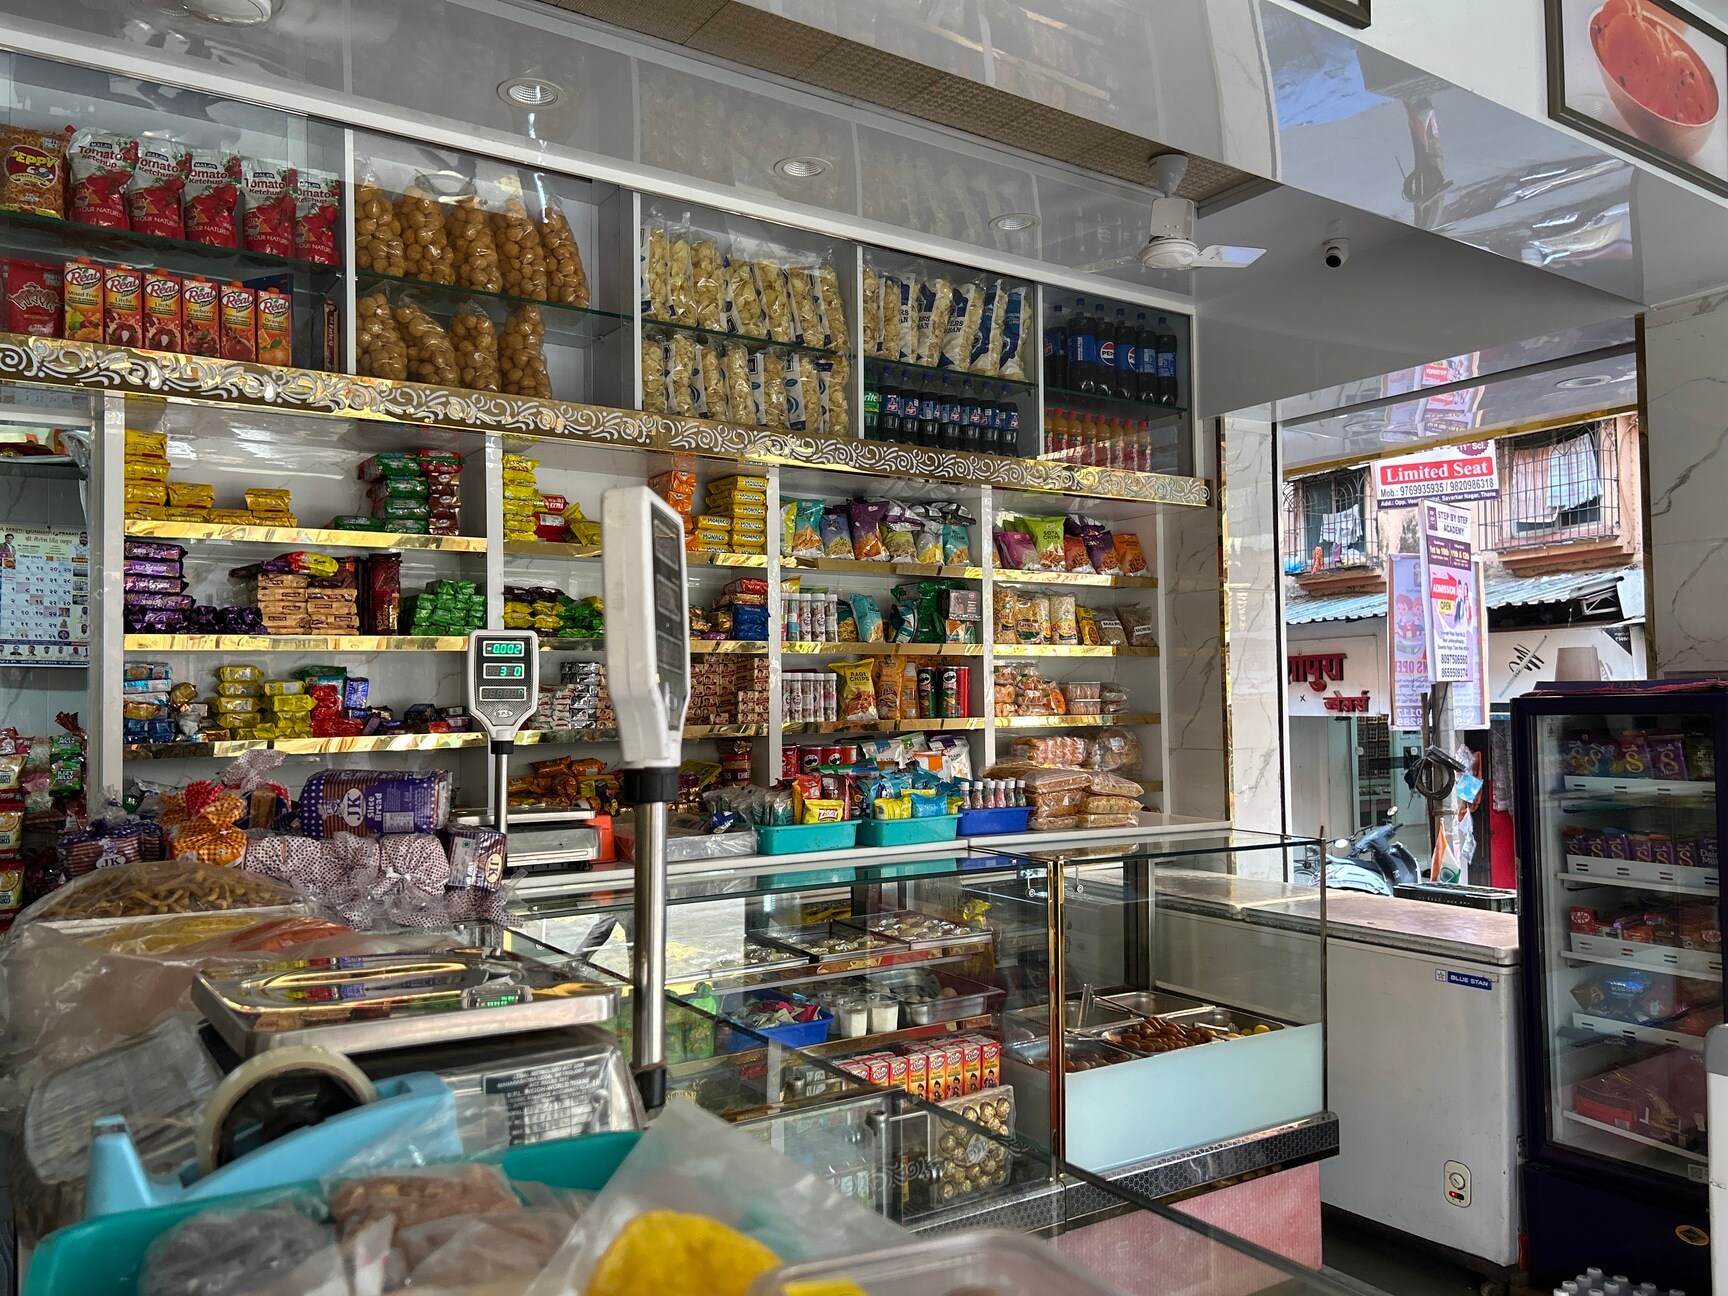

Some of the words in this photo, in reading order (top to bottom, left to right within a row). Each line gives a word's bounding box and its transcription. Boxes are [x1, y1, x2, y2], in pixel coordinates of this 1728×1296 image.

[9, 150, 58, 168] PEPPY
[78, 145, 123, 161] Tomato
[81, 154, 117, 169] Ketchup
[139, 157, 179, 173] omato
[138, 166, 174, 178] Ketchup
[190, 169, 228, 179] omato
[244, 178, 286, 189] Tomato
[298, 189, 332, 199] omato
[71, 271, 98, 284] Real
[110, 278, 138, 292] Real
[150, 283, 178, 297] Real
[188, 289, 215, 301] Real
[225, 295, 252, 307] Real
[186, 307, 215, 316] Cranberry
[263, 300, 288, 312] Real
[1386, 464, 1449, 482] Limited
[1453, 461, 1488, 476] Seat
[1380, 489, 1399, 498] Mob.:
[1400, 483, 1444, 496] 9769935935
[1450, 478, 1494, 491] 9820986318
[1438, 511, 1449, 520] STEP
[1450, 513, 1456, 522] BY
[1457, 515, 1468, 524] STEP
[1444, 524, 1465, 536] ACADEMY
[702, 533, 726, 541] MONACO
[1440, 601, 1452, 611] OPEN
[486, 643, 522, 654] -0.002
[346, 795, 362, 821] JK
[367, 796, 375, 819] Slice
[374, 792, 383, 821] Bread
[101, 857, 121, 868] JK
[489, 855, 498, 878] JK
[1451, 975, 1469, 983] BLUE
[1470, 979, 1488, 987] STAR
